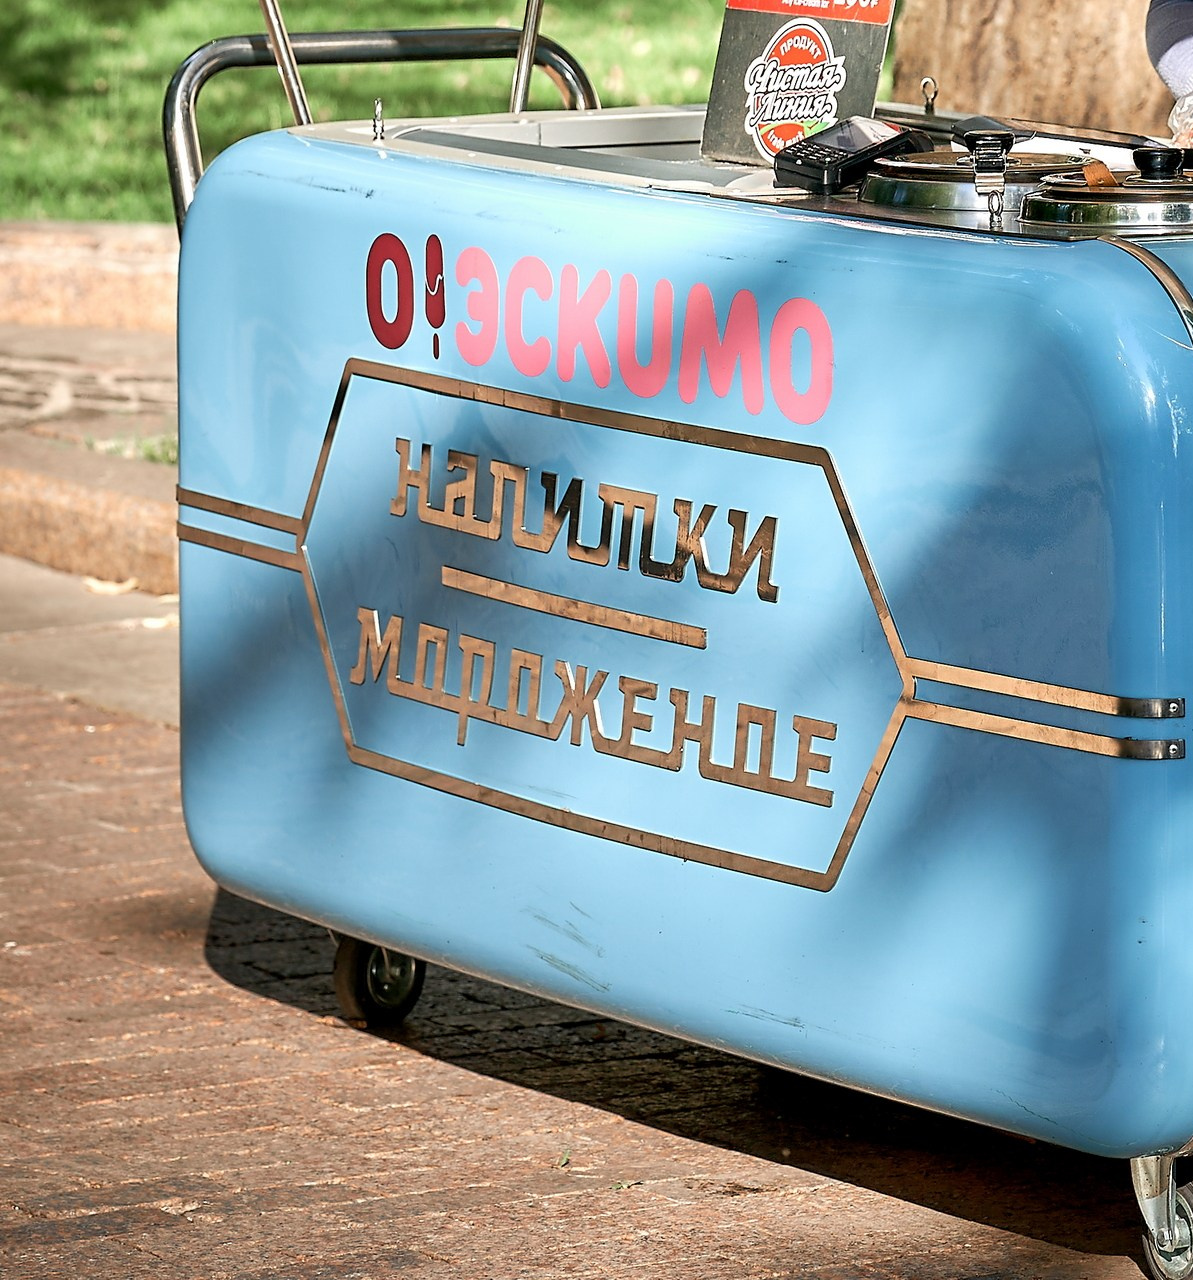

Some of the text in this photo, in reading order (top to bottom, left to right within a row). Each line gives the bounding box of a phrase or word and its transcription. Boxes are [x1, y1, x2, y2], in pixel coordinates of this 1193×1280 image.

[780, 35, 822, 60] ПРОДУКТ
[749, 59, 841, 94] Чистая
[749, 91, 834, 127] Линия
